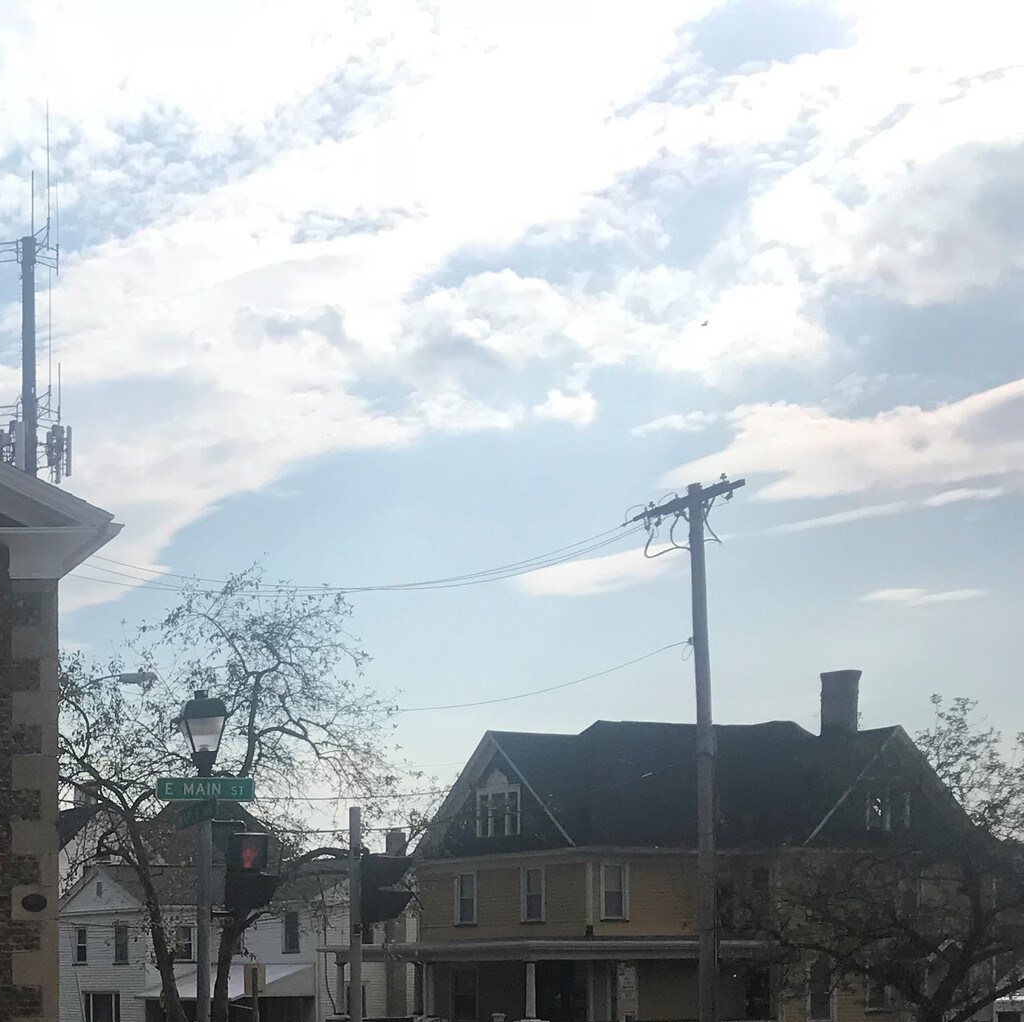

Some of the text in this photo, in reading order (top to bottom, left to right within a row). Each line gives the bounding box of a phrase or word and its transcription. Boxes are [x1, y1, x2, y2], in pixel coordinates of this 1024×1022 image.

[165, 783, 244, 796] E MAIN ST
